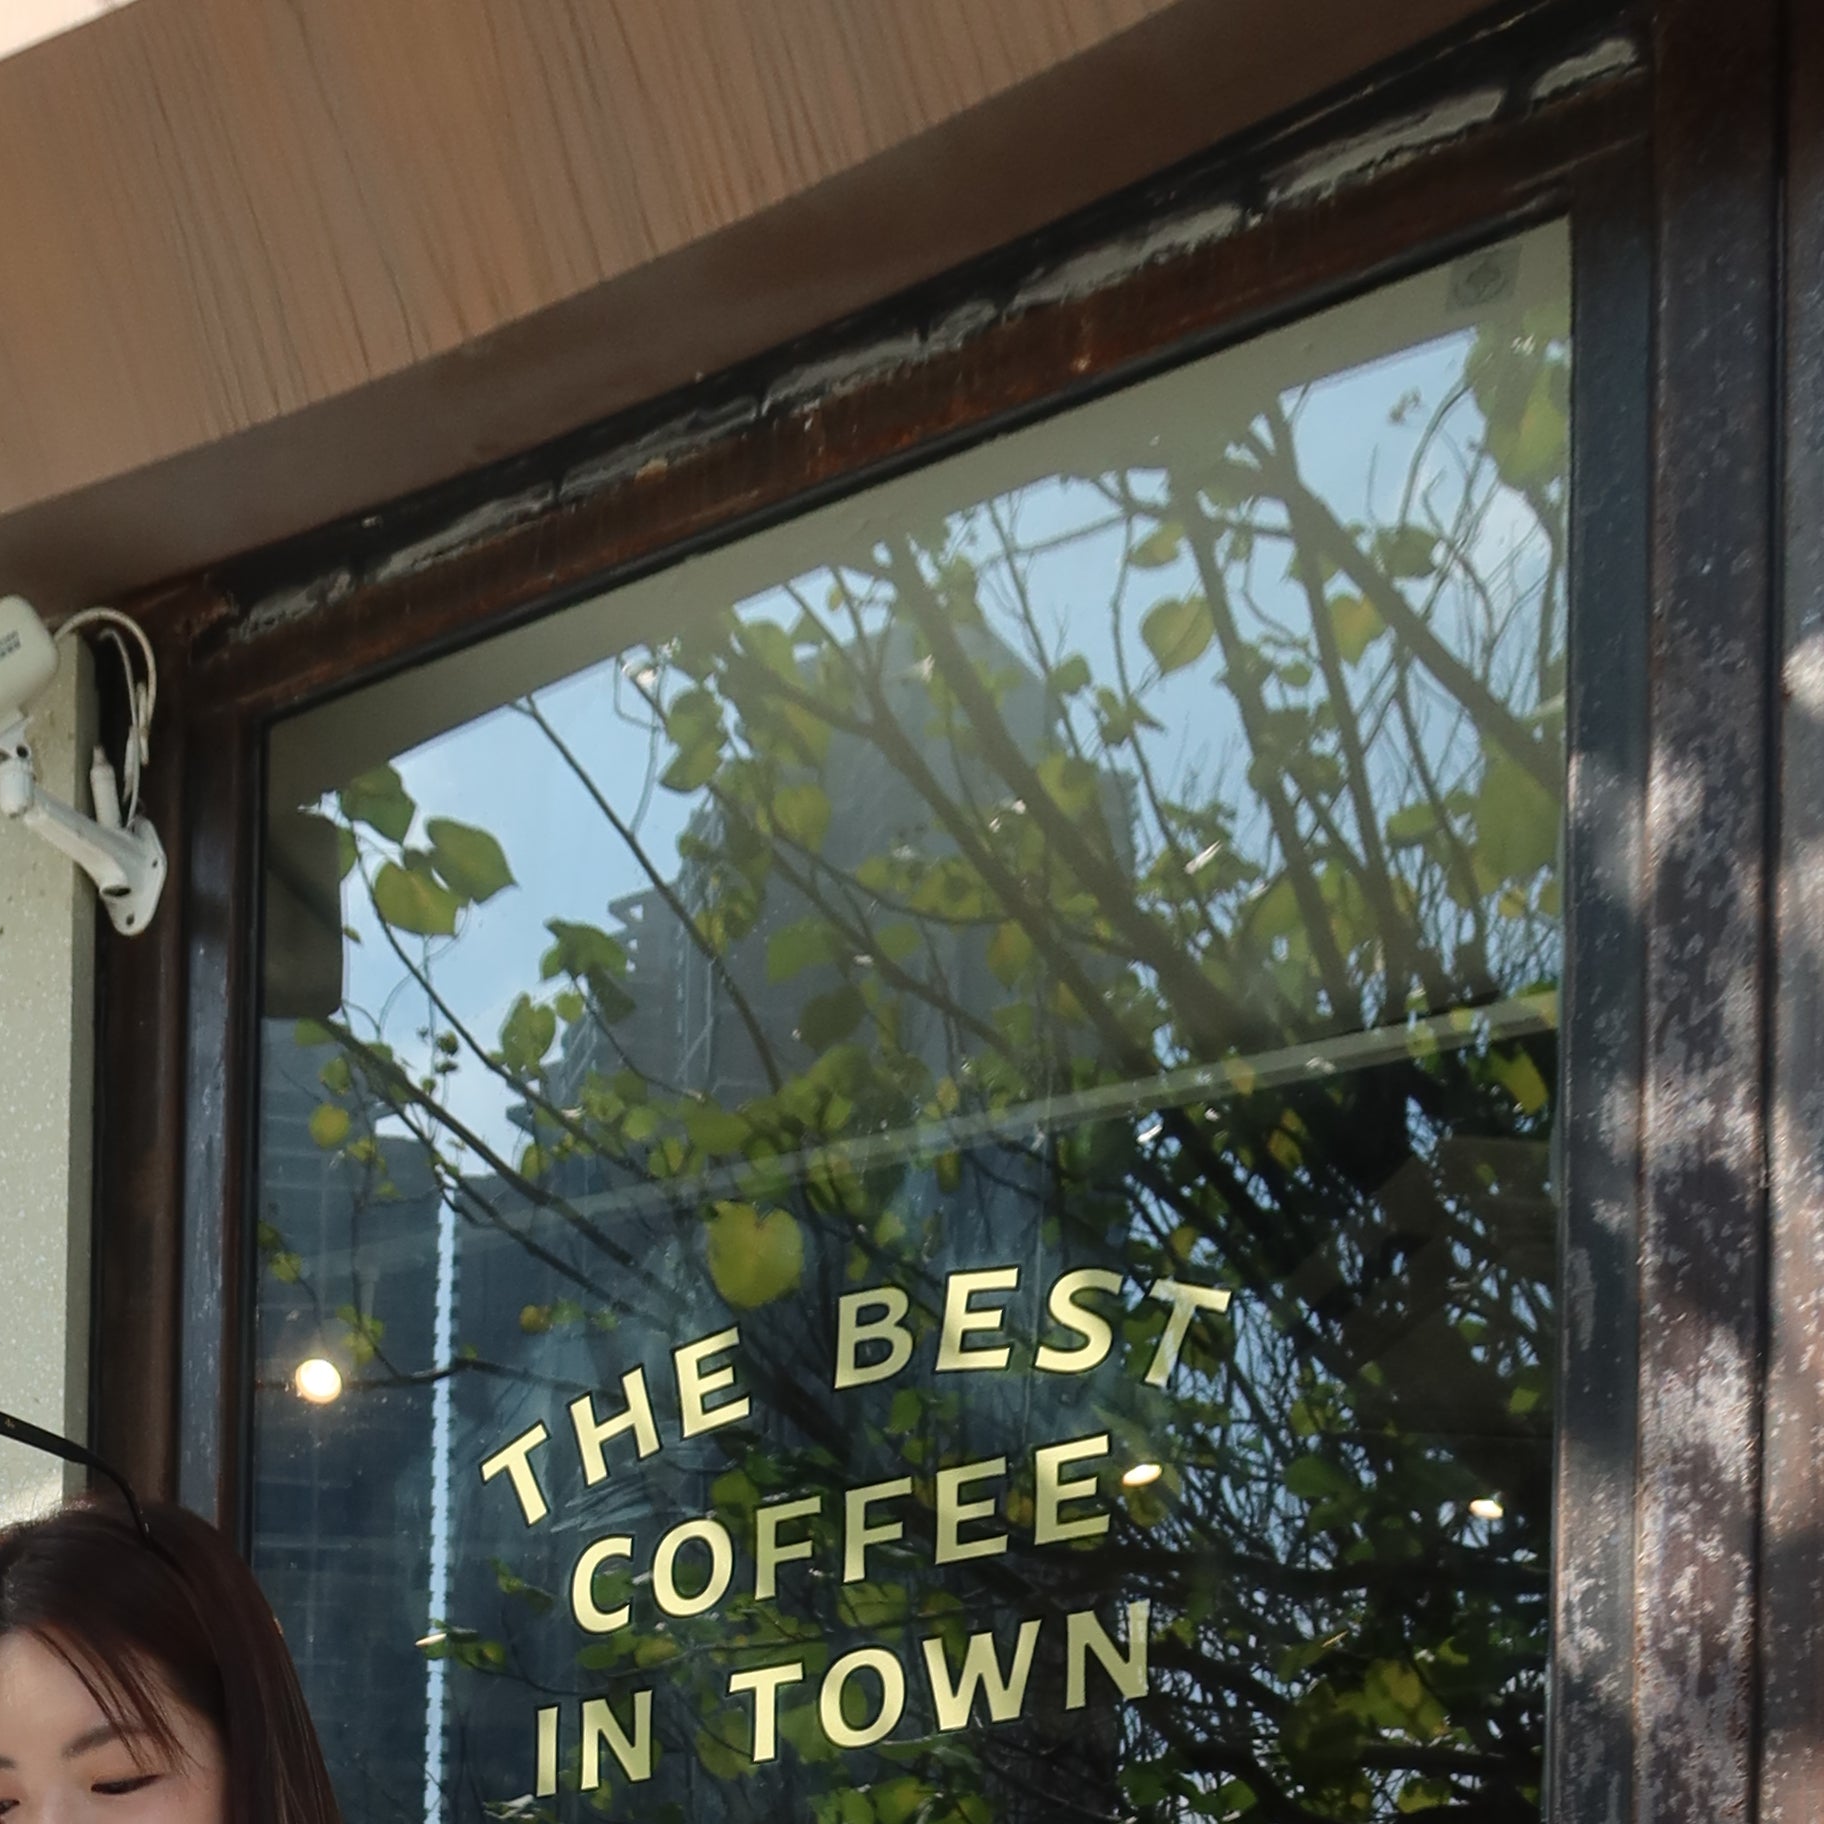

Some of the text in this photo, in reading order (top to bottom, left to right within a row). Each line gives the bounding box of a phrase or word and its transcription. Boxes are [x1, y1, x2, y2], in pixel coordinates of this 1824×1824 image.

[480, 1266, 1234, 1527] THE BEST
[570, 1432, 1114, 1637] COFFEE
[535, 1600, 1152, 1797] IN TOWN
